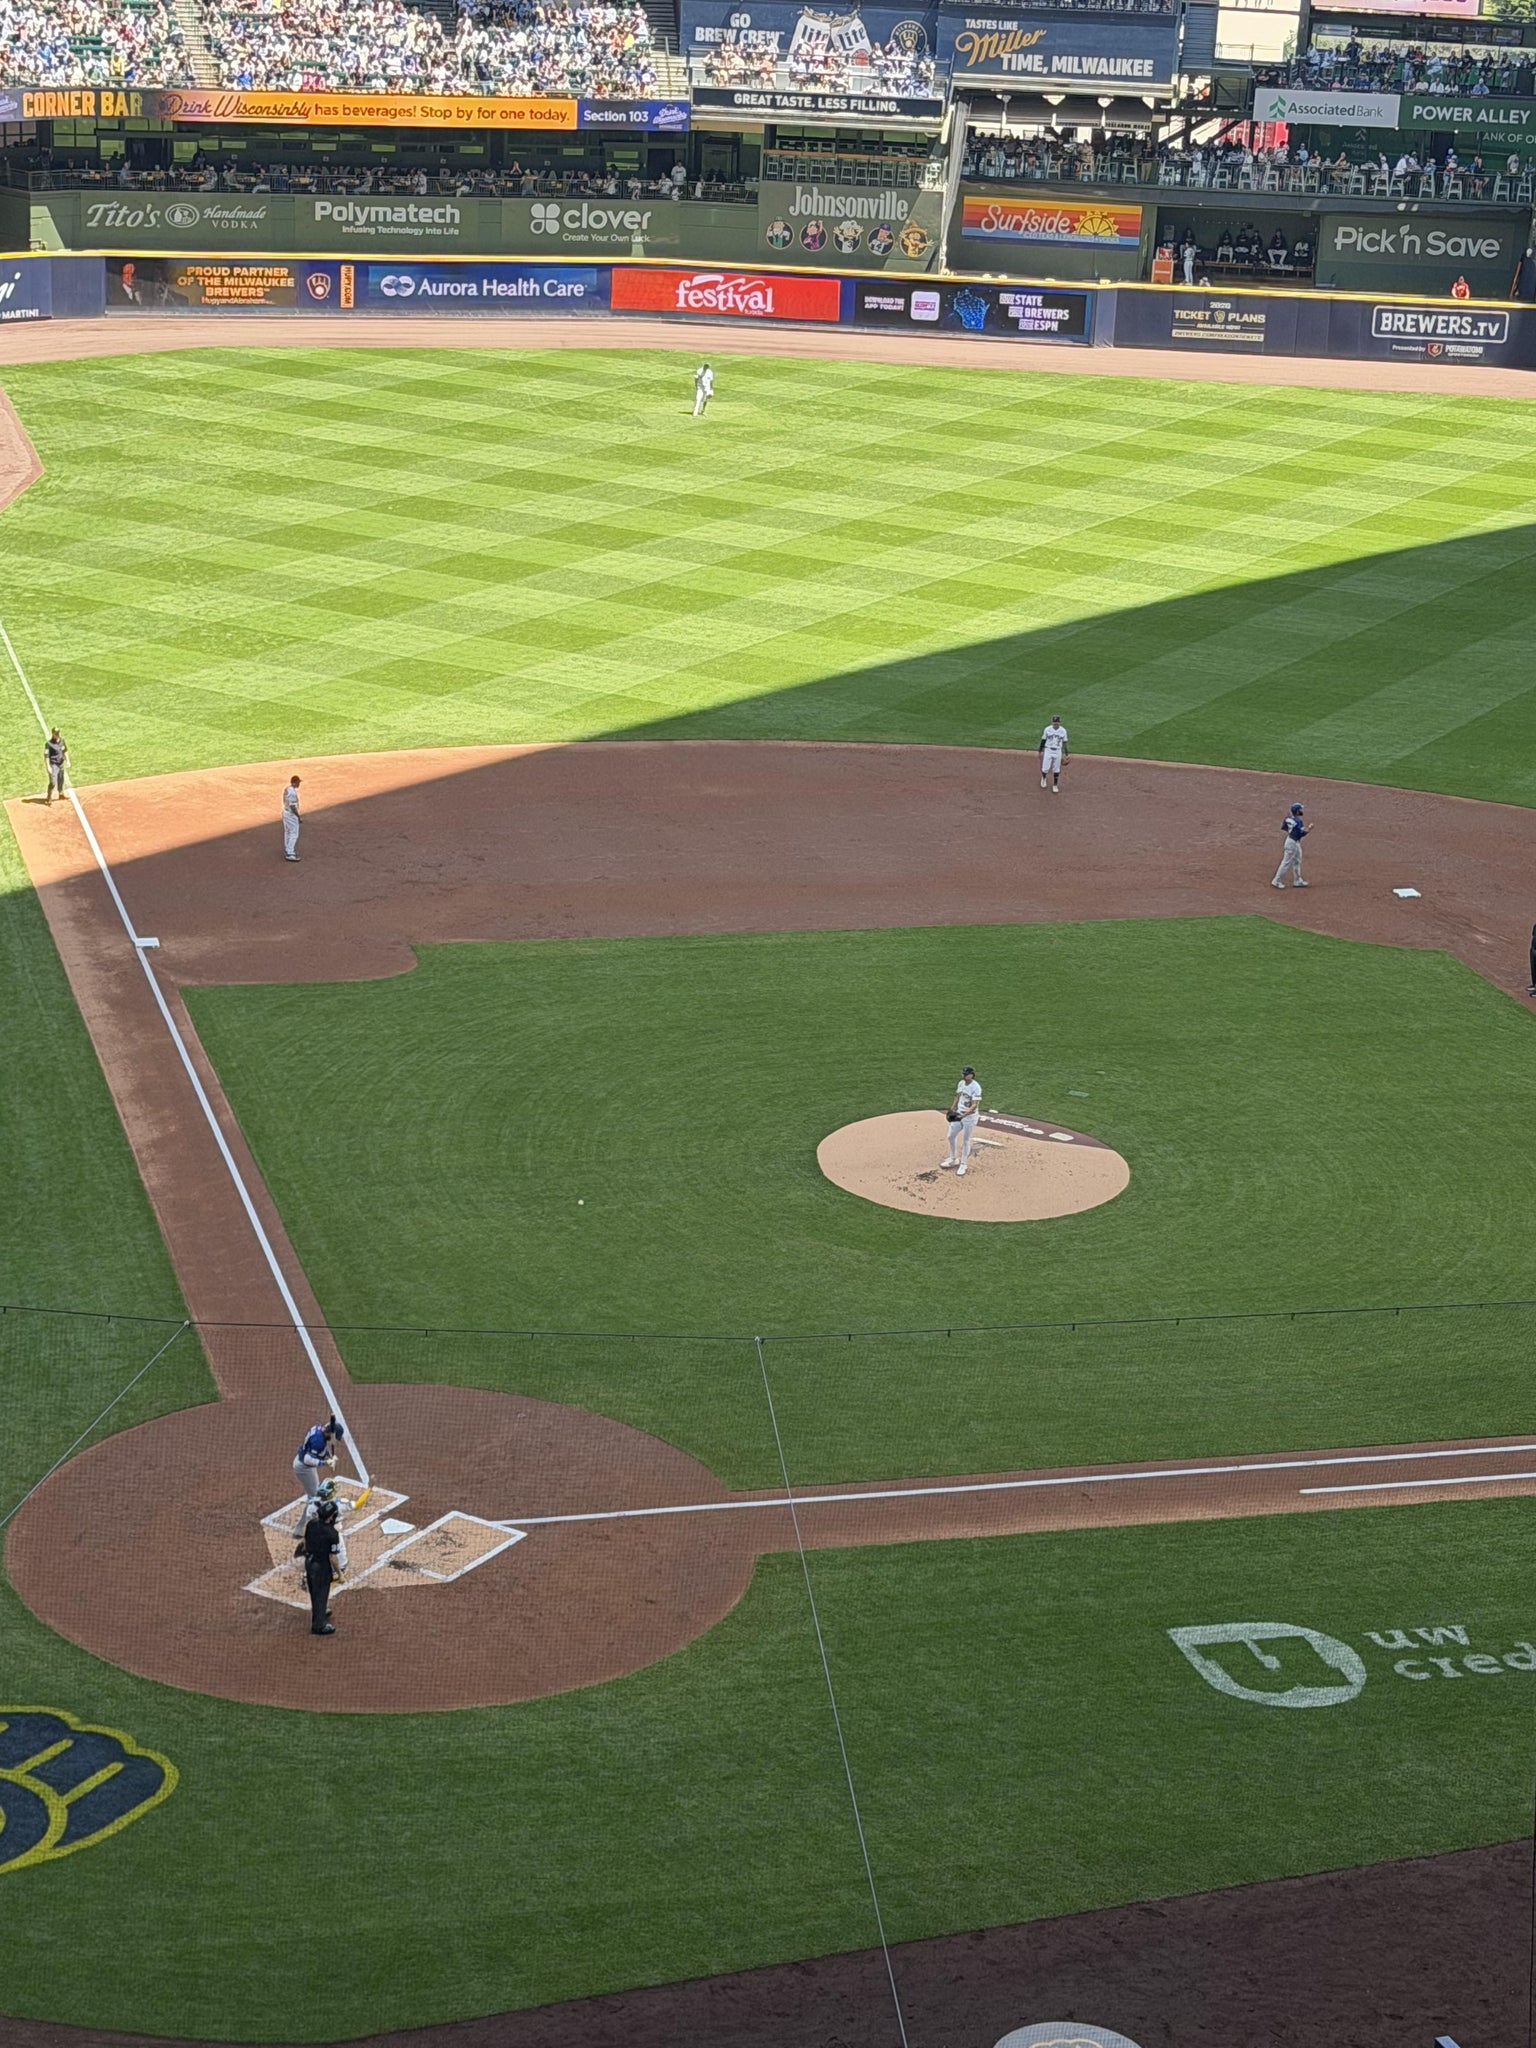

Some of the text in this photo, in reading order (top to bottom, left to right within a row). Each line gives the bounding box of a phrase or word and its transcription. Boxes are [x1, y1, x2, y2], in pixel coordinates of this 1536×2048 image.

[730, 13, 751, 28] GO
[965, 18, 1018, 31] TASTES LIKE
[695, 26, 737, 43] BREW
[955, 29, 1047, 67] Miller
[1000, 53, 1154, 77] TIME, MILWAUKEE
[23, 91, 96, 118] CORNER
[100, 91, 143, 117] BAR
[163, 94, 570, 123] Drink Wisconsinbly has beverages! Stop by for one today.
[734, 93, 901, 113] GREAT TASTE. LESS FILLING.
[584, 110, 626, 122] Section
[629, 110, 649, 122] 103
[1413, 105, 1531, 125] POWER ALLEY
[1476, 131, 1505, 142] ANK
[1507, 133, 1523, 143] OF
[203, 204, 267, 220] Handmade
[789, 186, 908, 221] Johnsonville
[87, 201, 160, 228] Tito's
[314, 201, 460, 225] Polymatech
[563, 203, 652, 230] clover
[981, 204, 1071, 234] Surfside
[212, 219, 258, 229] VODKA
[342, 225, 376, 235] Infusing
[377, 225, 424, 236] Technology
[443, 227, 460, 236] Life
[562, 233, 589, 242] Create
[590, 233, 609, 242] Your
[611, 234, 630, 243] Own
[1334, 226, 1397, 253] Pick
[1426, 231, 1500, 259] Save
[186, 266, 289, 277] PROUD PARTNER
[177, 276, 295, 287] OF THE MILWAUKEE
[418, 278, 585, 297] Aurora Health Care
[675, 275, 775, 314] festival
[1015, 294, 1043, 306] STATE
[2, 309, 39, 319] MARTINI
[1025, 307, 1070, 320] BREWERS
[1173, 309, 1266, 324] TICKET PLANS
[1034, 319, 1059, 332] ESPN
[1380, 312, 1500, 337] BREWERS.TV
[1363, 1624, 1471, 1650] uw
